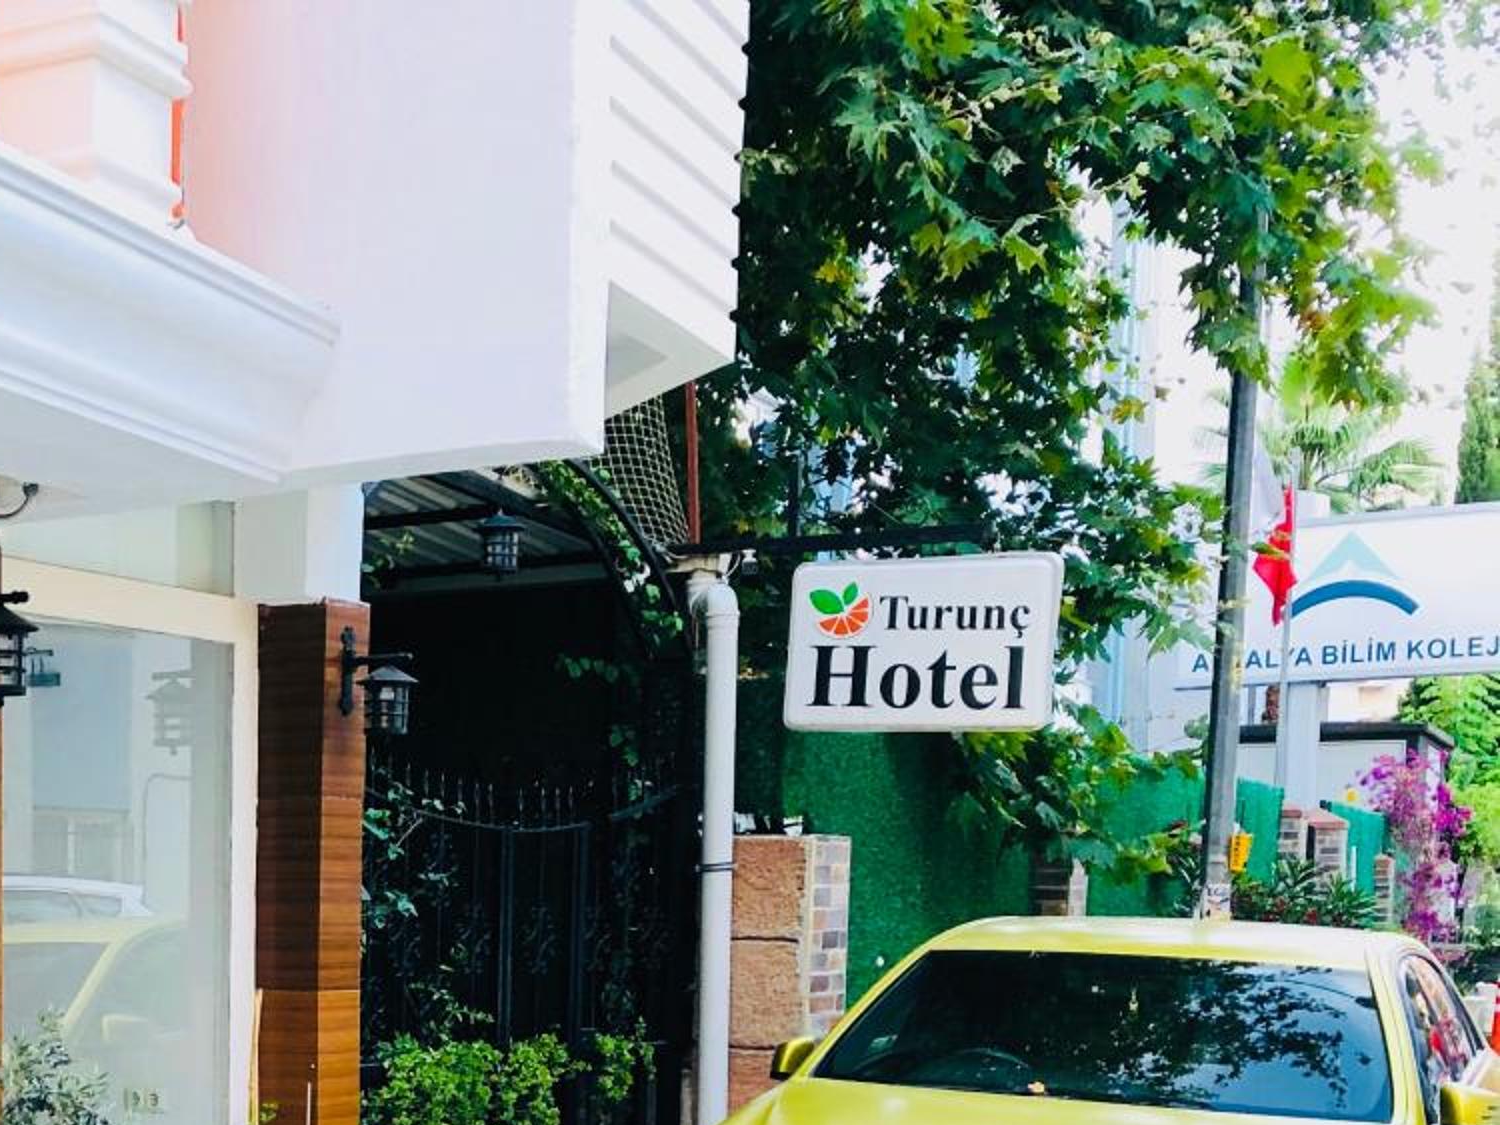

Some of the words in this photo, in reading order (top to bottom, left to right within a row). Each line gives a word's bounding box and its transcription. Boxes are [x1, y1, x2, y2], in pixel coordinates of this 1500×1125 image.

[880, 595, 1031, 638] Turunç
[1192, 646, 1313, 672] AALA
[1321, 637, 1396, 665] BİLİM
[1407, 635, 1500, 660] KOLEJ
[805, 645, 1025, 710] Hotel
